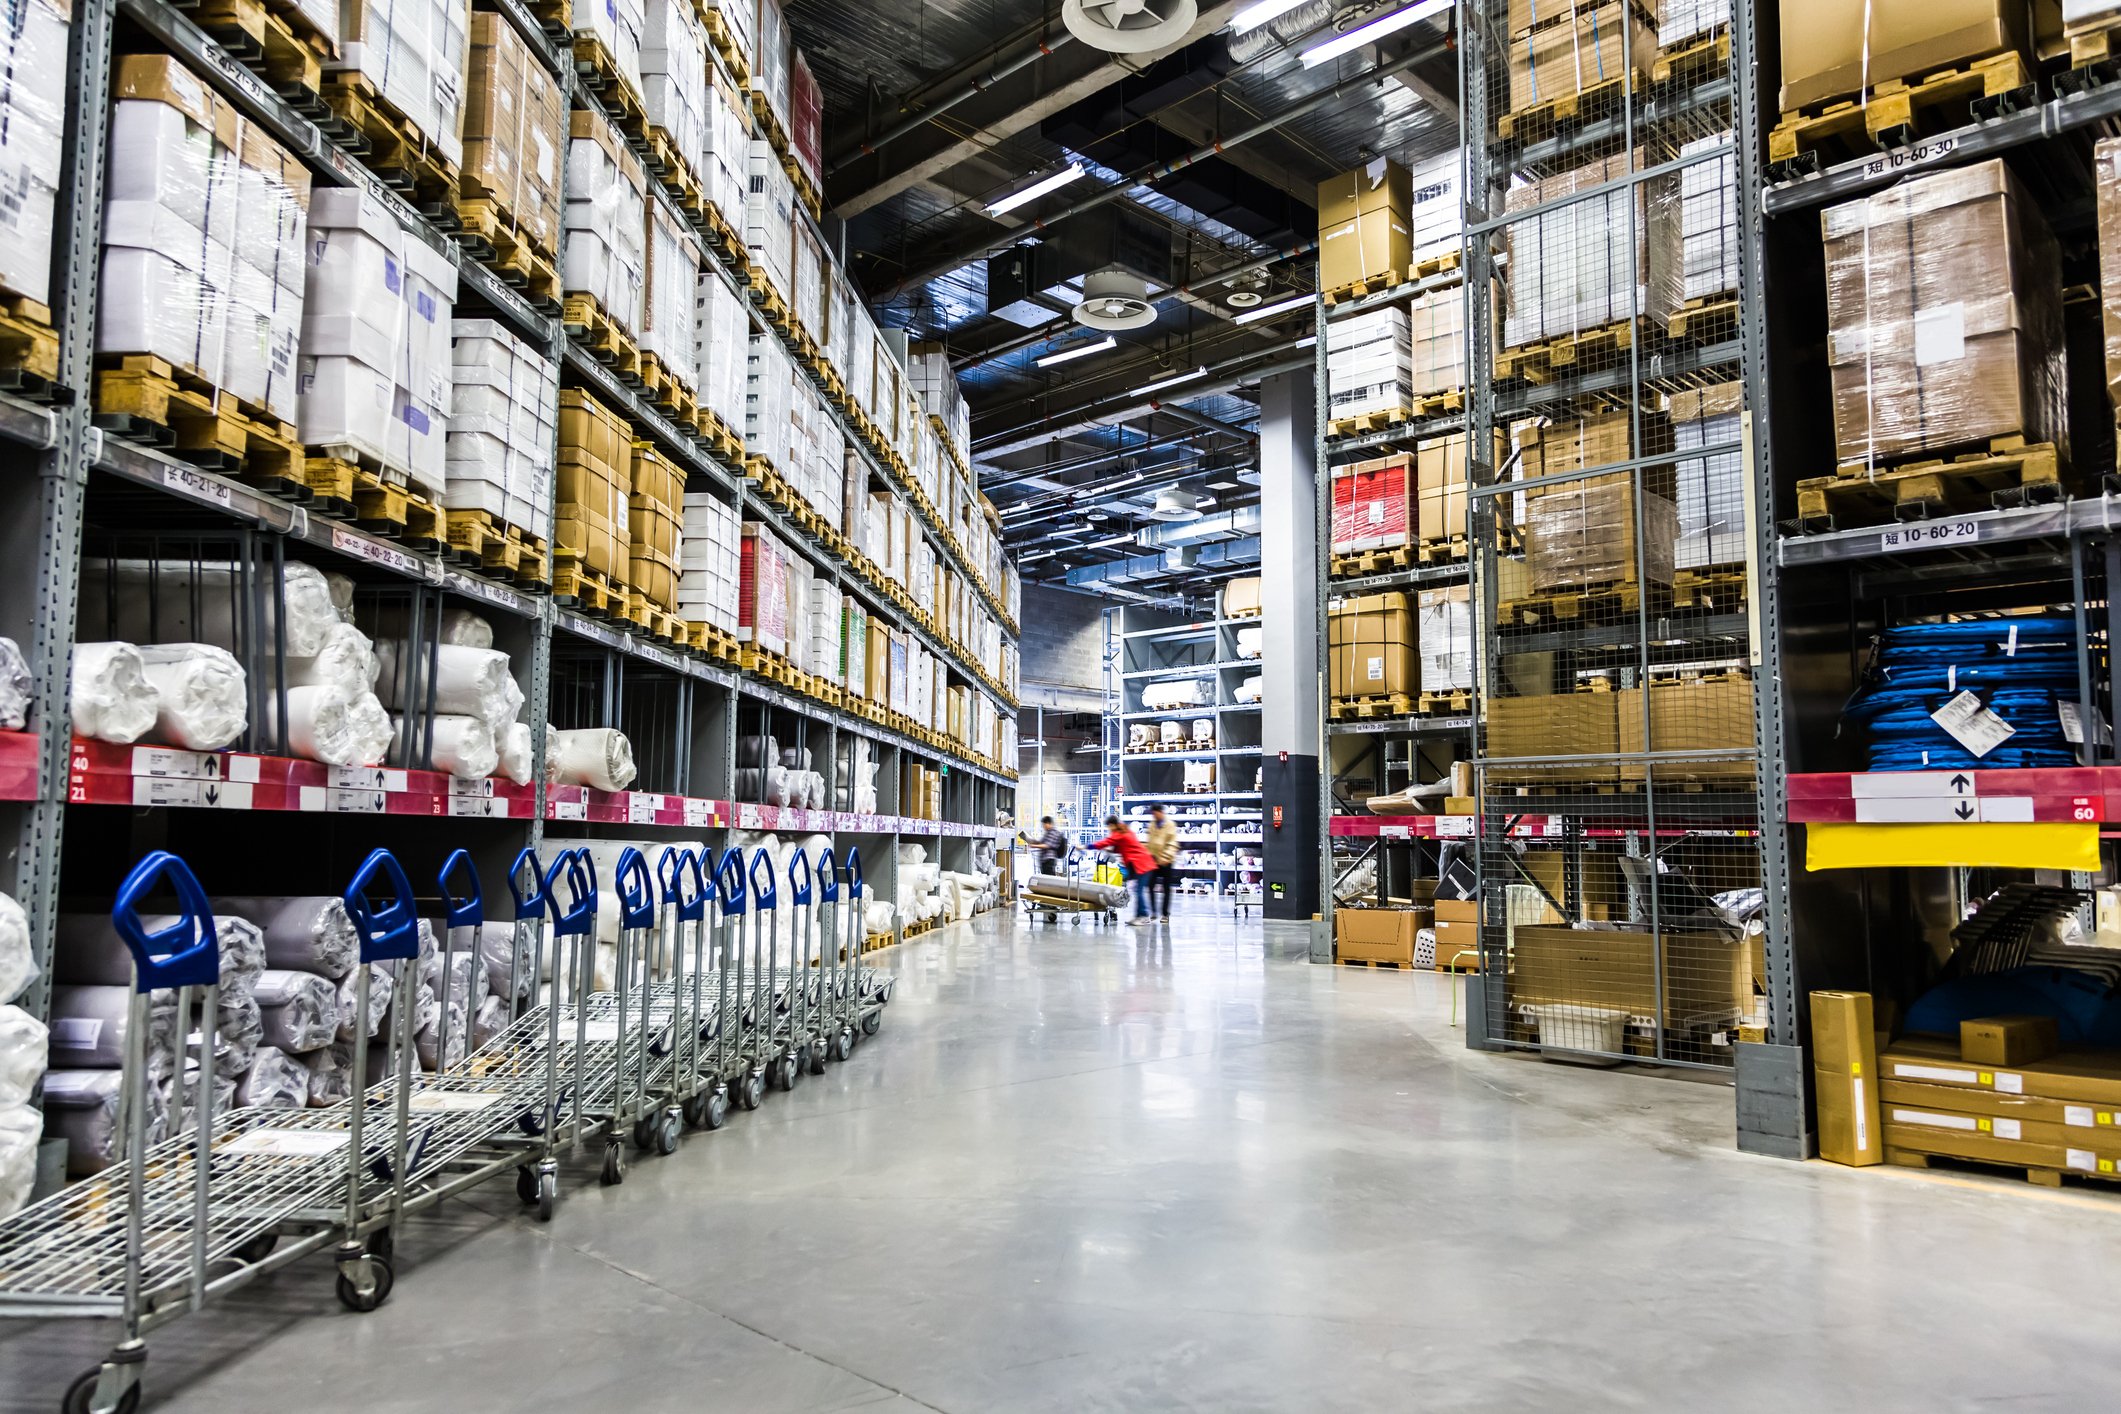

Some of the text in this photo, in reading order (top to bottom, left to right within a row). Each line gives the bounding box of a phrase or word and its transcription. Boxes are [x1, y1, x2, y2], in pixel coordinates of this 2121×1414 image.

[1868, 139, 1953, 176] 短 10-60-30
[181, 470, 228, 499] 40-21-20
[1886, 522, 1975, 546] 短 10-60-20
[370, 545, 403, 567] 40-22-20
[73, 757, 89, 771] 40
[71, 787, 87, 801] 21
[2074, 807, 2095, 820] 60
